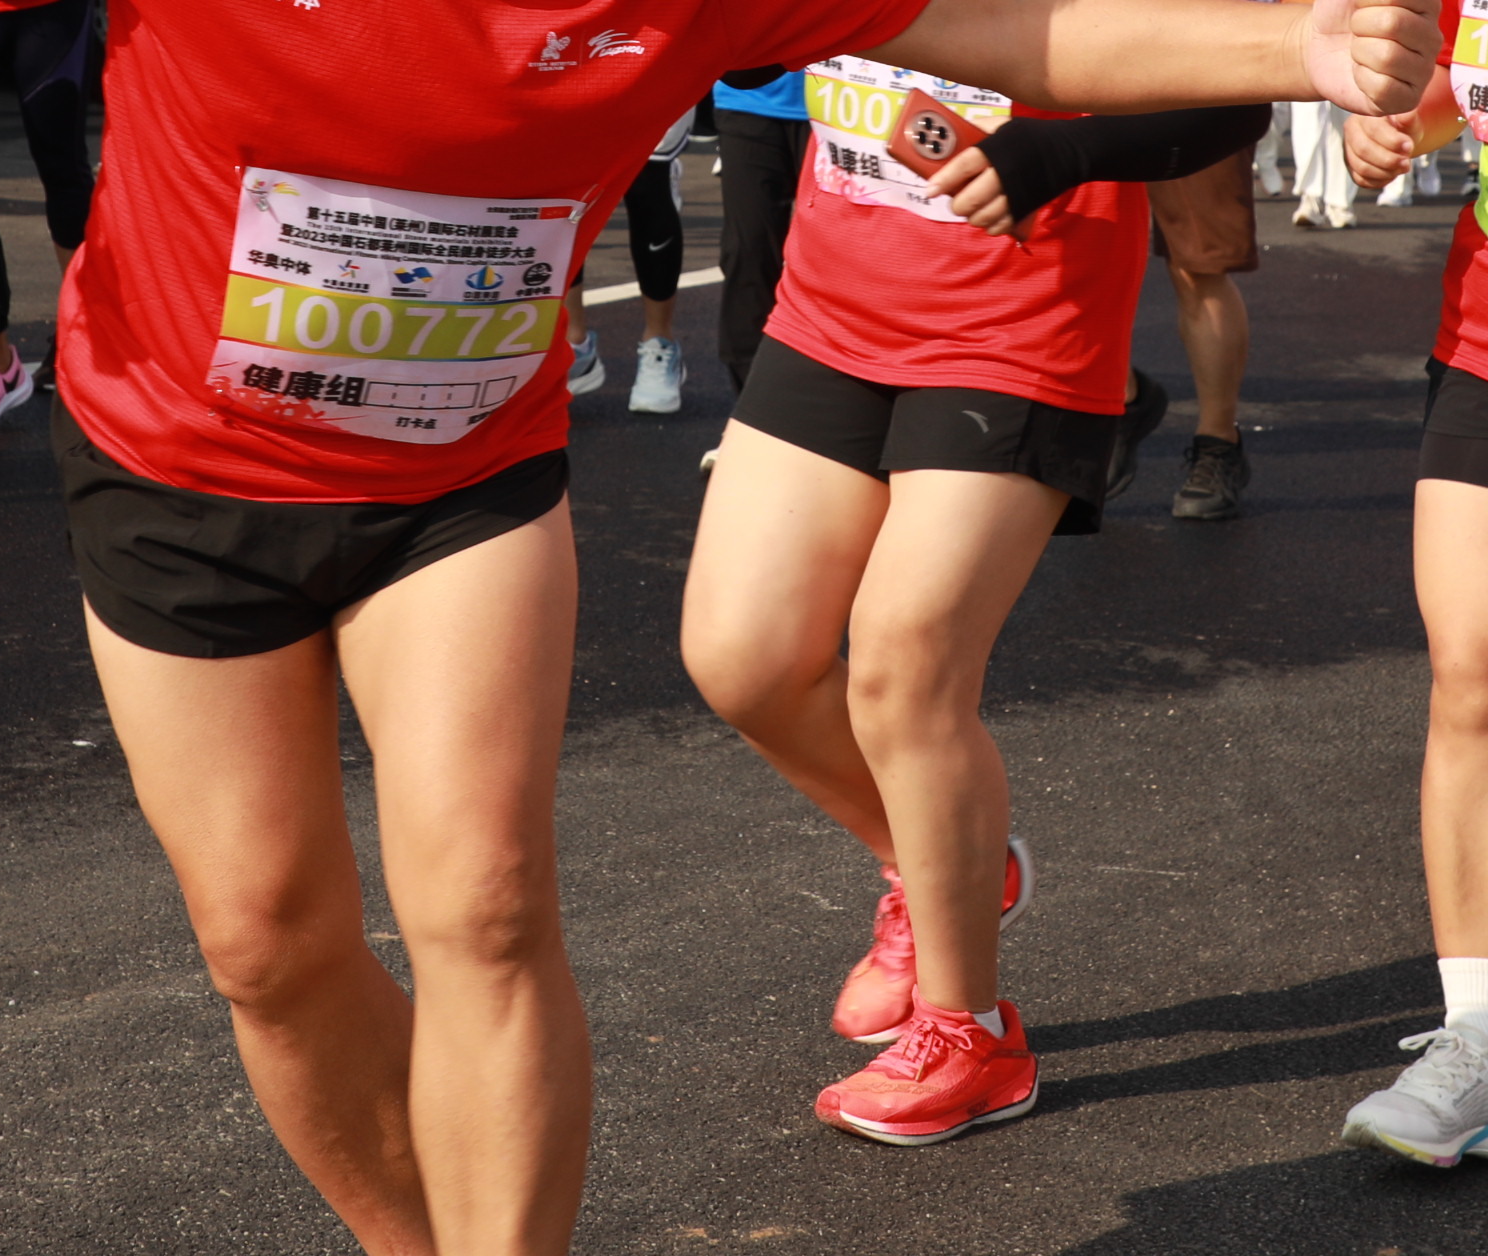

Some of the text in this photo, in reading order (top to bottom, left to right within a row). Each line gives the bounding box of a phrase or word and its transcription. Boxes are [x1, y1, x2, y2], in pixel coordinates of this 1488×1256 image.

[247, 249, 312, 275] 华奥中体
[250, 286, 539, 357] 100772
[242, 364, 366, 407] 健康组
[395, 417, 438, 430] 打卡点
